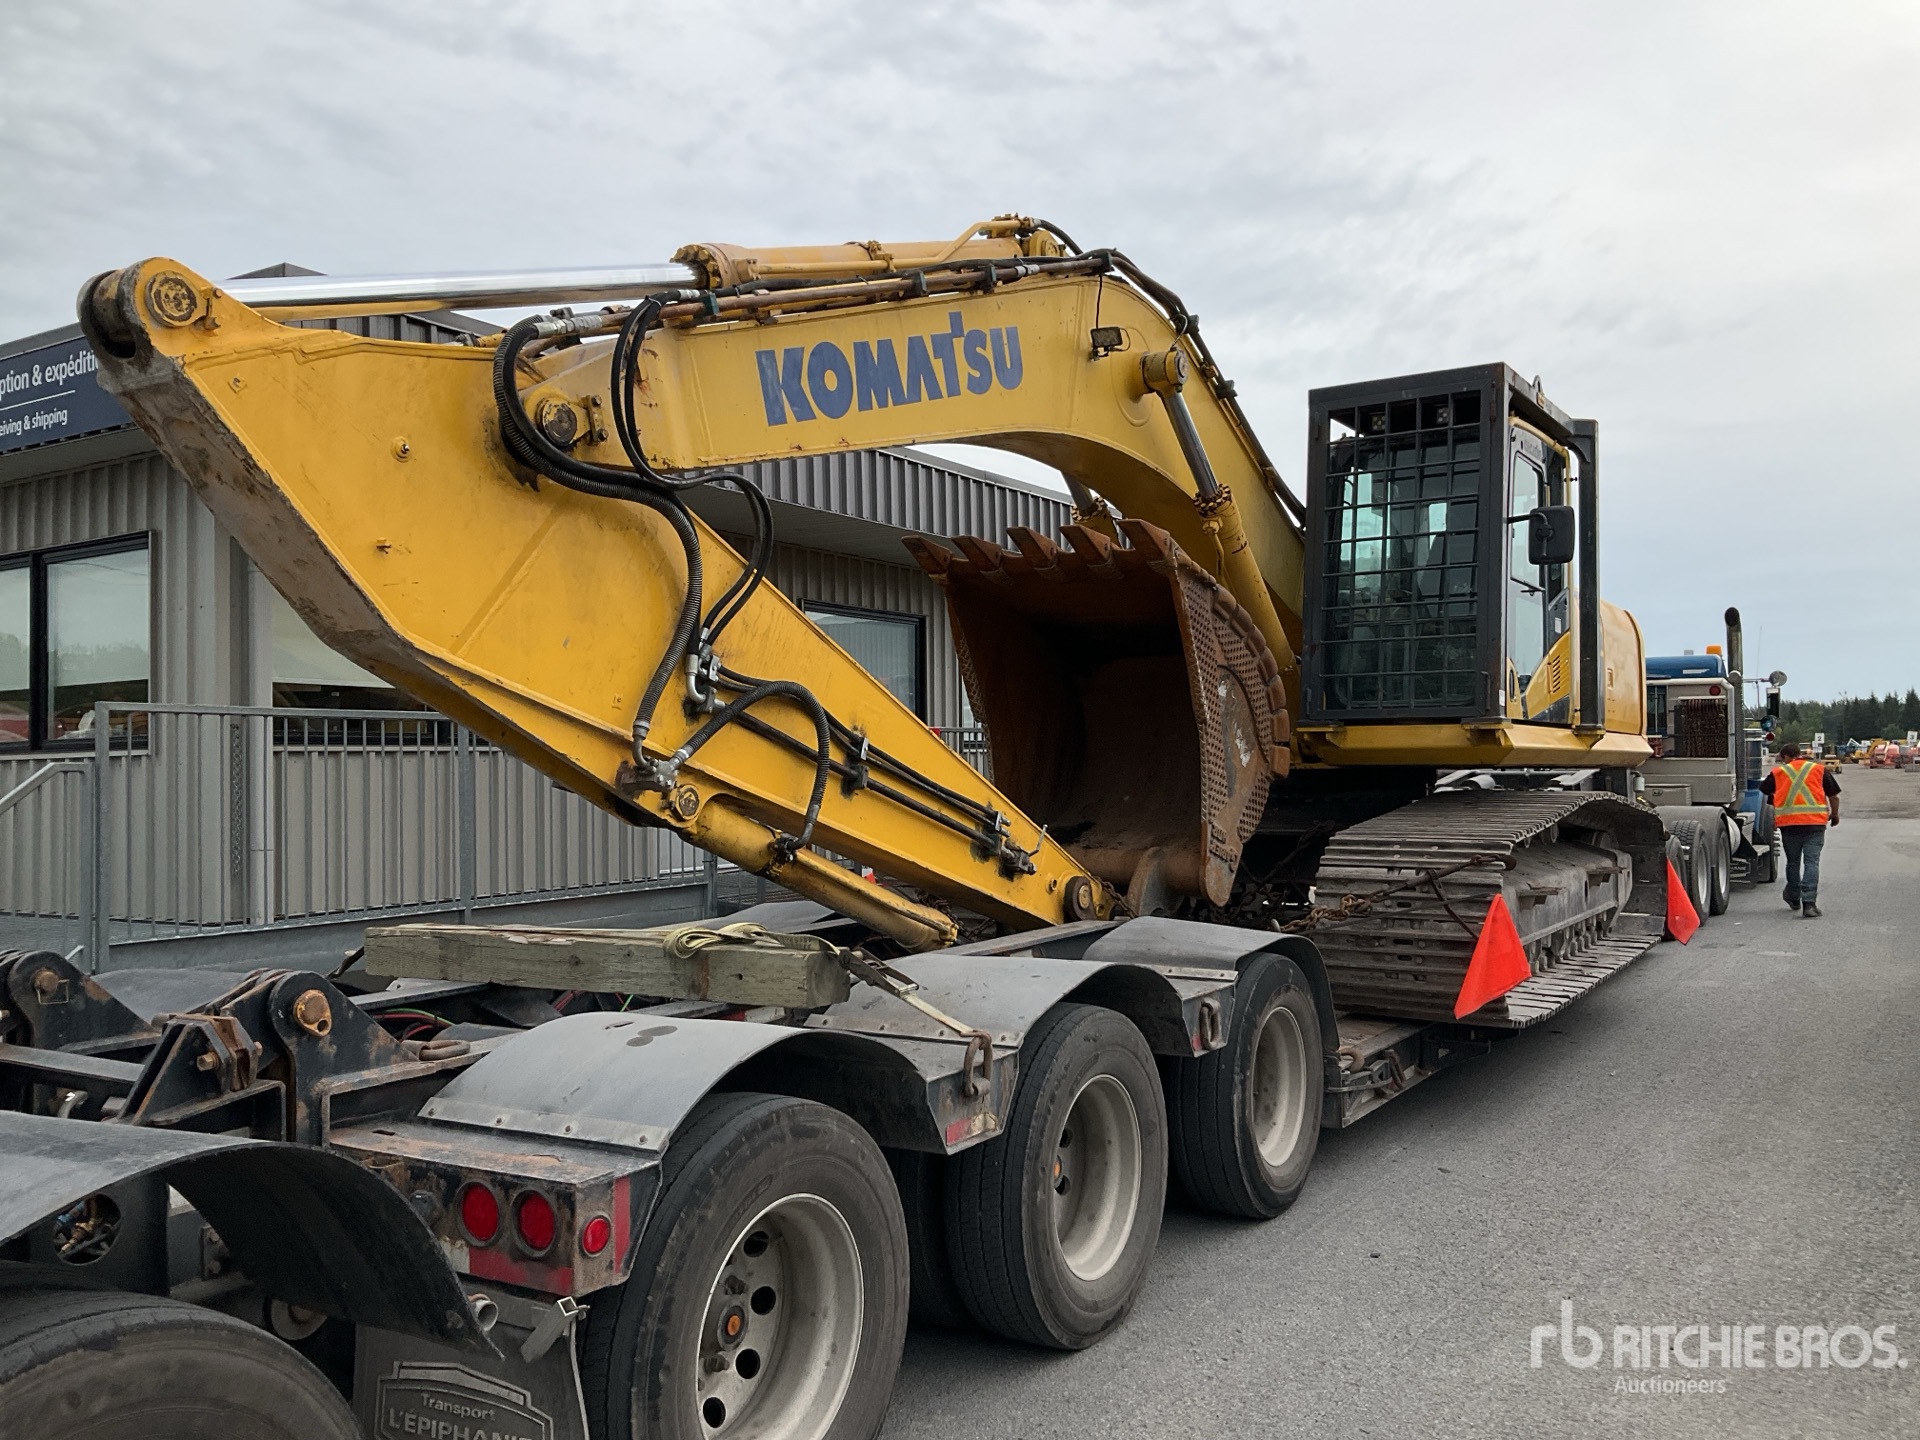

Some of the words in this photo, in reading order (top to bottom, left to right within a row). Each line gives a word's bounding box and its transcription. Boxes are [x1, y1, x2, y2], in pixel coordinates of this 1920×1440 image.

[32, 364, 42, 387] &
[755, 311, 1023, 427] KOMATSU
[24, 415, 31, 430] &
[32, 408, 68, 430] shipping
[421, 1393, 496, 1421] Transport
